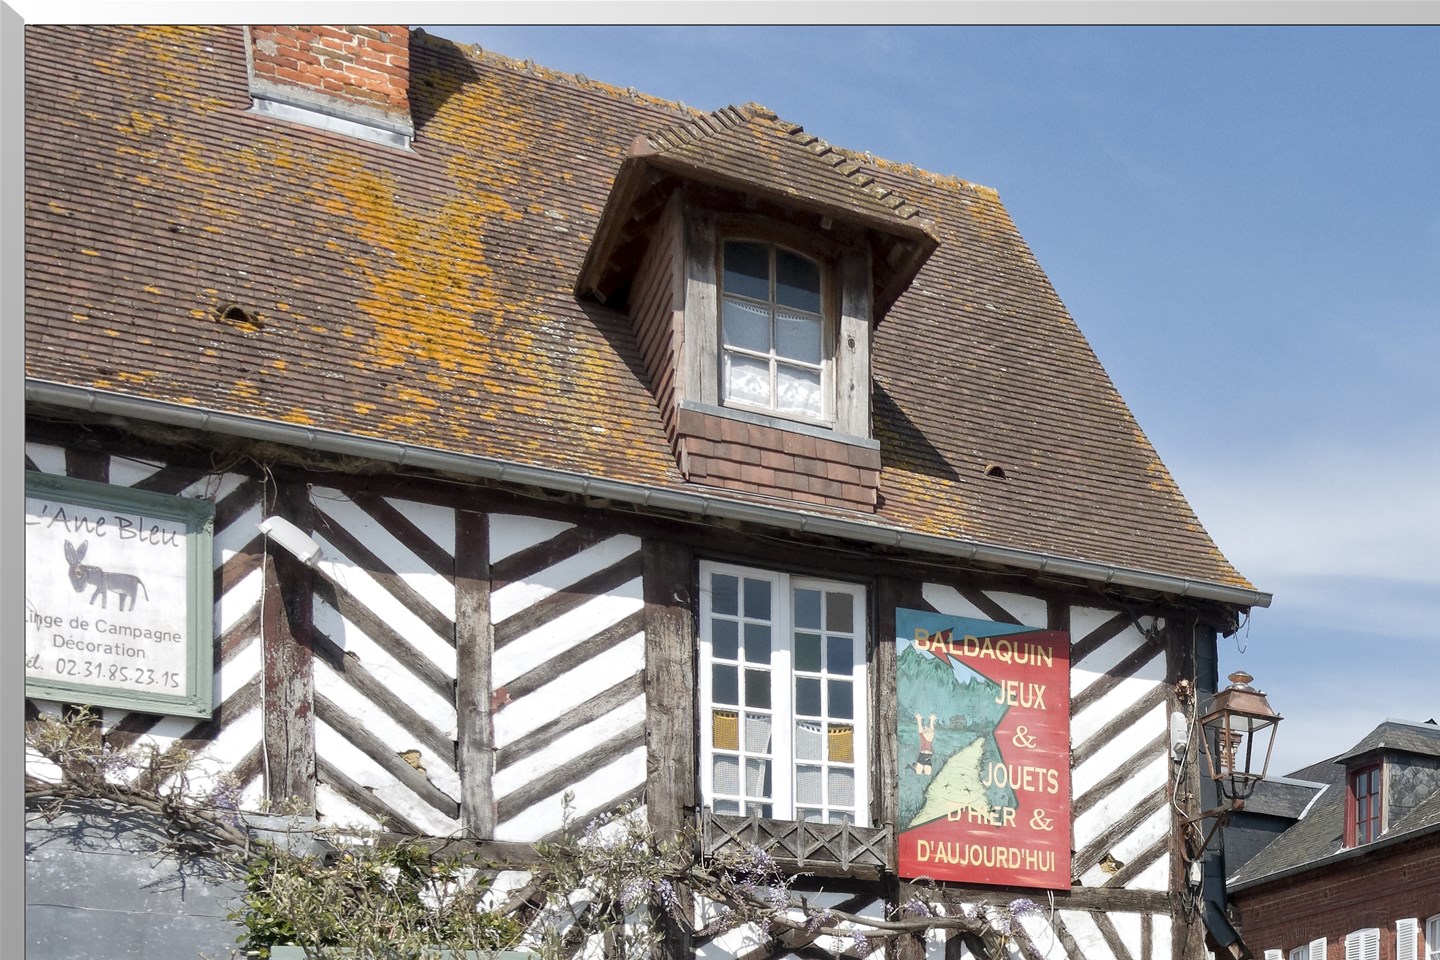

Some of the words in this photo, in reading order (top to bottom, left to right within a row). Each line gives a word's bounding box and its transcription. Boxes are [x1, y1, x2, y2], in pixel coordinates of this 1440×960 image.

[115, 515, 179, 547] Bleu
[26, 609, 63, 629] inge
[69, 616, 89, 631] de
[95, 619, 182, 643] Campagne
[53, 634, 146, 659] Décoration
[914, 628, 1053, 668] BALDAQUIN
[26, 654, 44, 670] él.
[56, 658, 180, 688] 02.31.85.23.15
[995, 679, 1047, 710] JEUX
[1012, 725, 1037, 749] &
[983, 762, 1059, 795] JOUETS
[947, 802, 1016, 828] D'HIER
[1029, 808, 1054, 831] &
[917, 839, 1055, 872] D'AUJOURD'HUI
